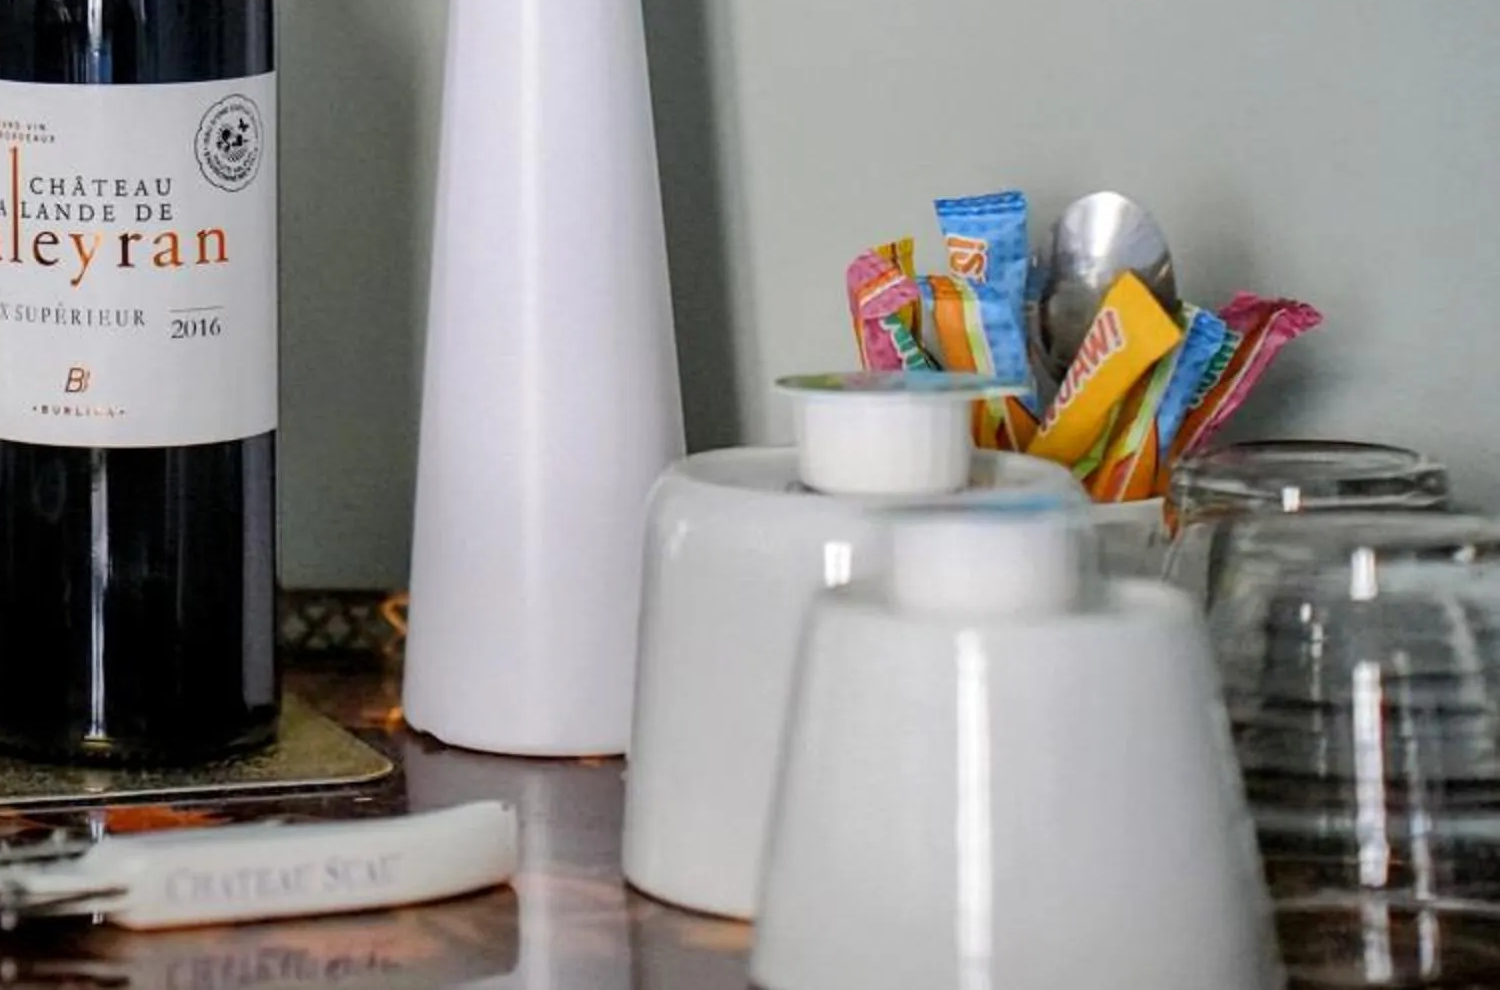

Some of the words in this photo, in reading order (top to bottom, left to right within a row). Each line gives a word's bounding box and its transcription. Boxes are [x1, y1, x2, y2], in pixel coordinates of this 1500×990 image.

[29, 176, 172, 197] CHÂTEAU
[20, 201, 116, 222] LANDE
[136, 203, 174, 221] DE
[171, 318, 222, 340] 2016
